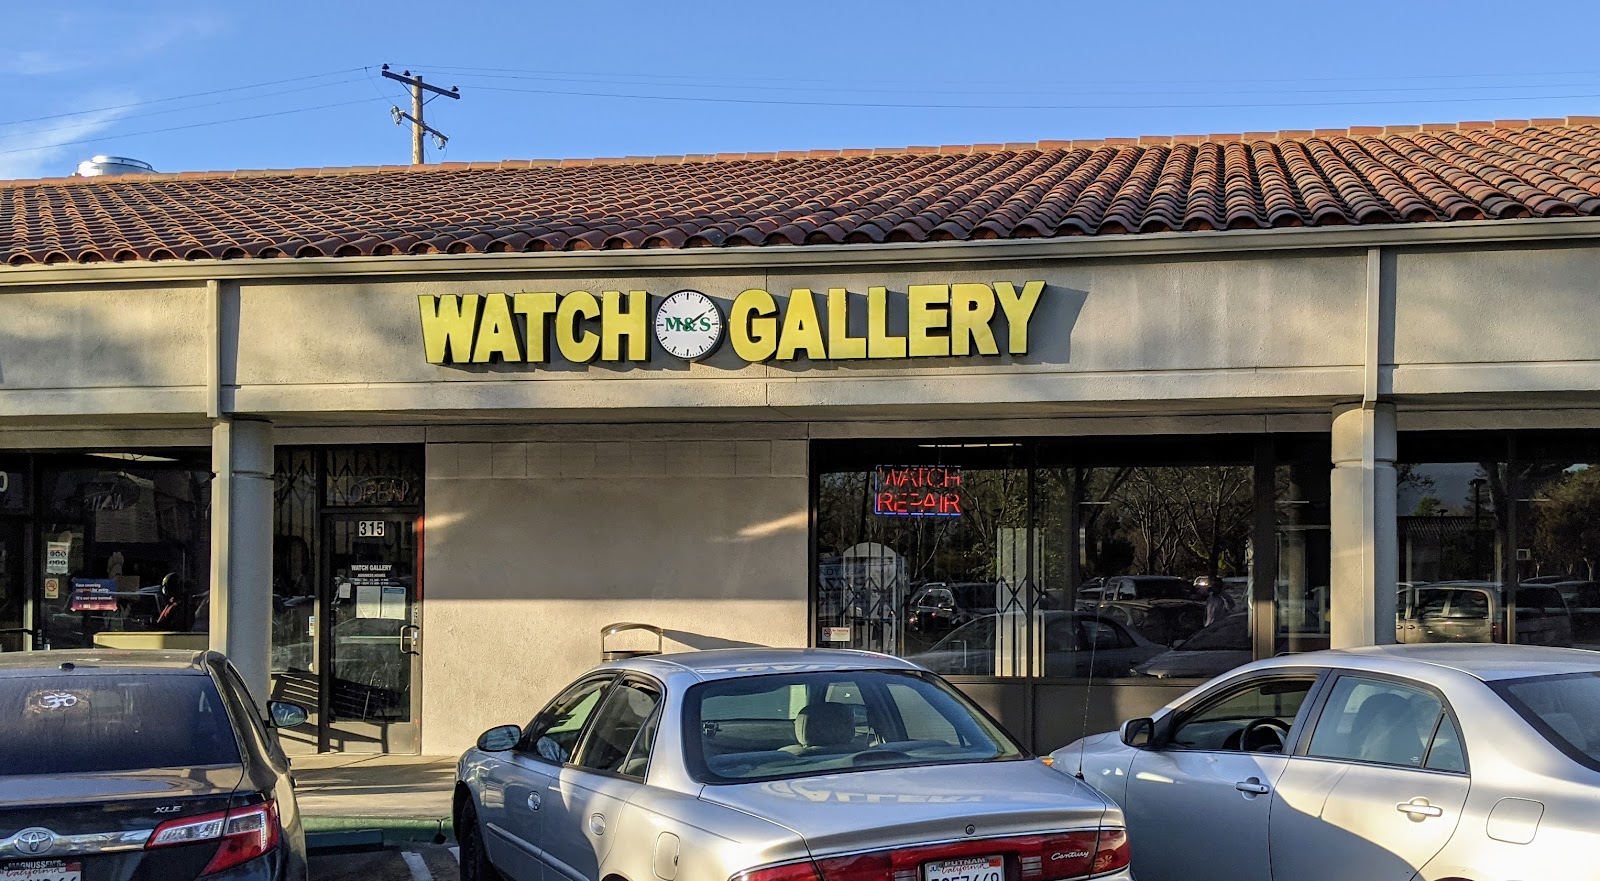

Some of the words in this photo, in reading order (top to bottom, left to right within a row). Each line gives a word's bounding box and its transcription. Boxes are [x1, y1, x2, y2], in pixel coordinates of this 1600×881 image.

[417, 290, 647, 363] WATCH
[729, 280, 1046, 361] GALLERY
[665, 317, 711, 332] M&S
[879, 467, 960, 487] WATCH
[877, 493, 960, 512] REPAIR
[360, 521, 383, 535] 315
[153, 805, 182, 814] XLE
[944, 858, 987, 867] PUTNAM
[1051, 851, 1089, 861] Century
